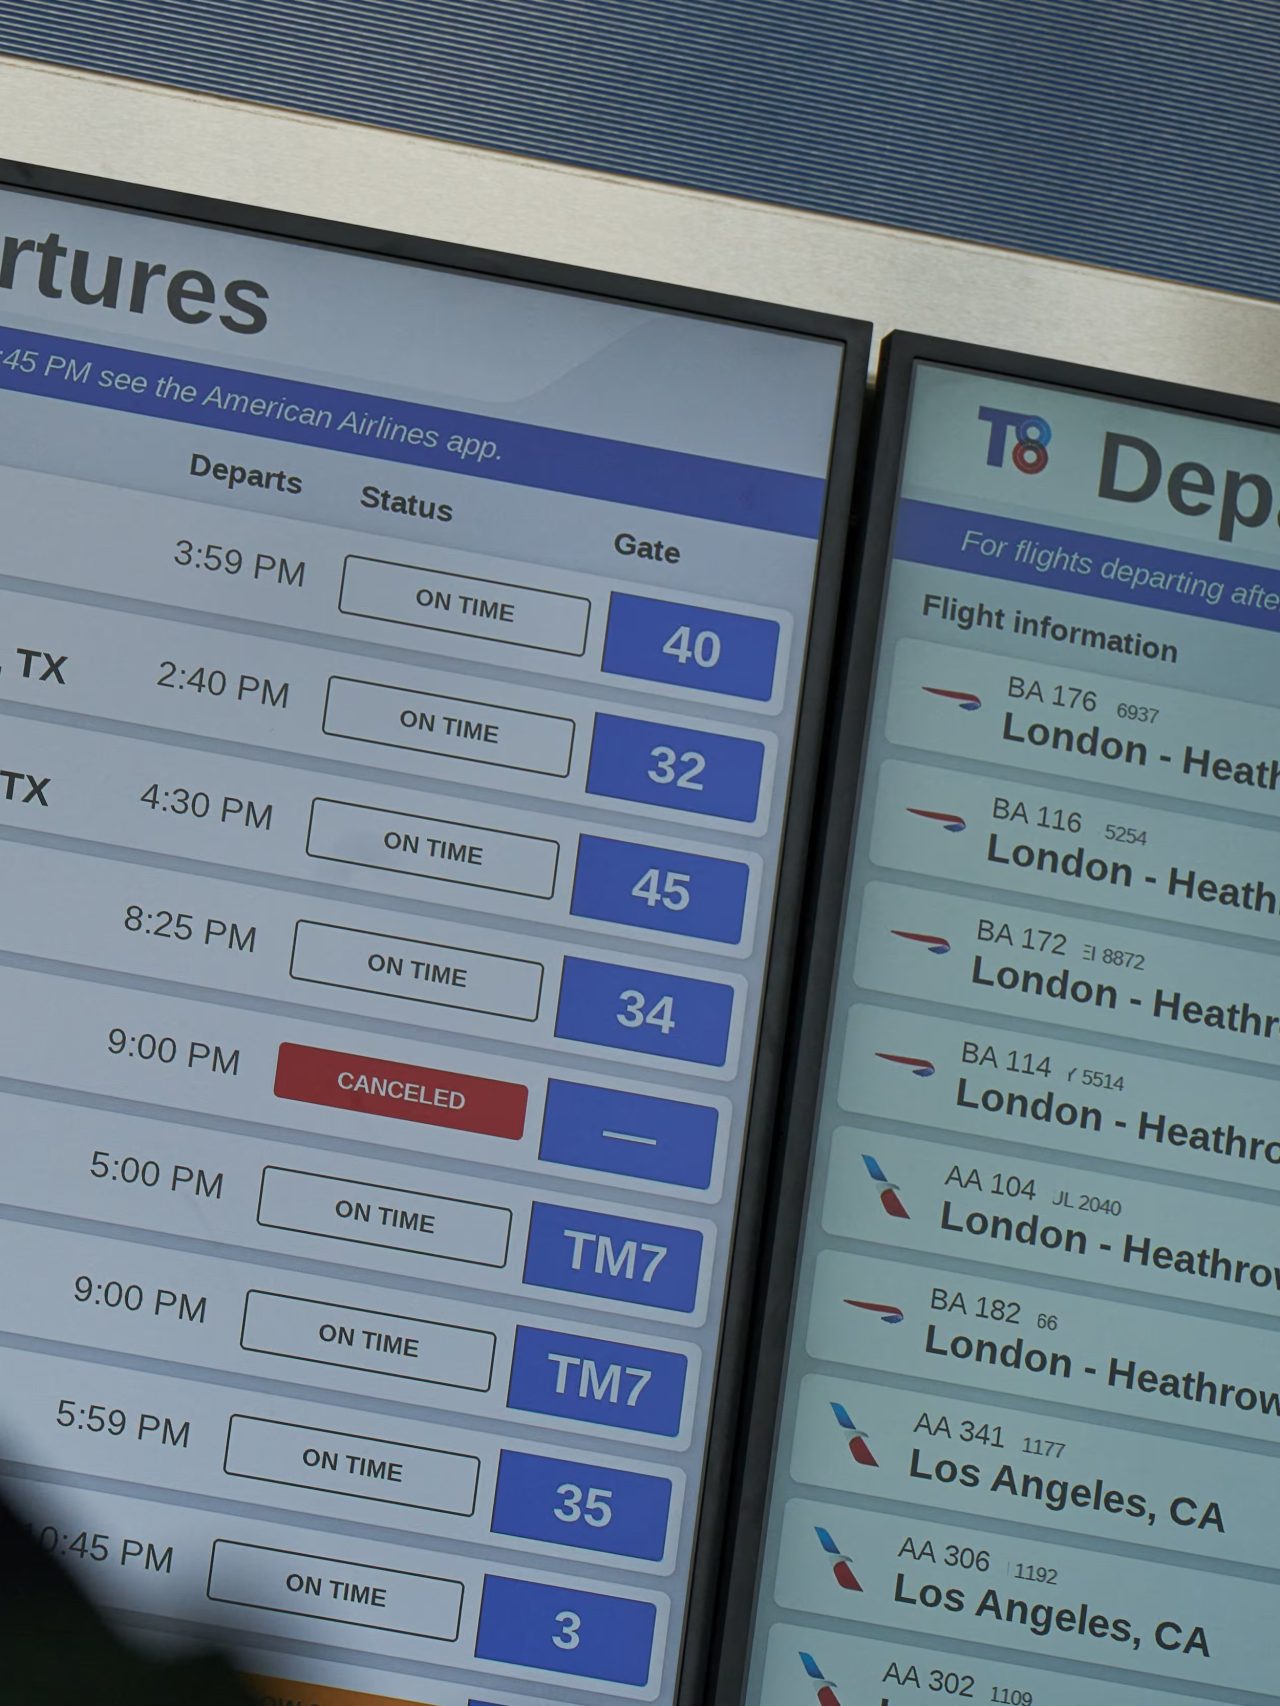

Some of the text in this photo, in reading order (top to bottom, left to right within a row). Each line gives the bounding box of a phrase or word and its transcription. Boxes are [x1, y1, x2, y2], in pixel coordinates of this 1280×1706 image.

[43, 354, 93, 383] PM
[98, 370, 148, 394] see
[155, 376, 198, 403] the
[201, 385, 333, 429] American
[336, 410, 439, 448] Airlines
[446, 434, 501, 463] app.
[977, 405, 1052, 475] T8
[189, 453, 681, 565] Departs Status Gate
[173, 539, 306, 588] 3:59 PM
[960, 529, 1225, 605] For flights departing
[662, 625, 722, 668] 40
[922, 594, 1178, 664] Flight information
[16, 647, 69, 685] TX
[156, 660, 290, 709] 2:40 PM
[1007, 675, 1160, 724] BA 176 6937
[1002, 711, 1147, 766] London
[0, 769, 51, 807] TX
[647, 745, 706, 791] 32
[140, 783, 273, 831] 4:30 PM
[992, 797, 1147, 846] BA 116 5254
[383, 831, 484, 866] ON TIME
[987, 832, 1133, 888] London
[631, 868, 691, 911] 45
[124, 904, 257, 953] 8:25 PM
[977, 918, 1145, 971] BA 172 8872
[971, 954, 1118, 1010] London
[616, 989, 676, 1035] 34
[107, 1027, 240, 1076] 9:00 PM
[961, 1041, 1124, 1092] BA 114 5514
[337, 1071, 466, 1110] CANCELED
[956, 1077, 1103, 1132] London
[90, 1150, 224, 1200] 5:00 PM
[944, 1165, 1122, 1217] AA 104 JL 2040
[335, 1199, 436, 1235] ON TIME
[940, 1200, 1087, 1255] London
[563, 1229, 668, 1283] TM7
[74, 1275, 207, 1324] 9:00 PM
[930, 1287, 1058, 1331] BA 182 66
[925, 1324, 1072, 1379] London
[547, 1353, 652, 1407] TM7
[56, 1399, 191, 1449] 5:59 PM
[912, 1412, 1066, 1459] AA 341 1177
[302, 1448, 404, 1483] ON TIME
[553, 1483, 613, 1528] 35
[909, 1448, 1226, 1534] Los Angeles, CA
[120, 1539, 174, 1574] PM
[897, 1536, 1058, 1586] AA 306 1192
[551, 1610, 582, 1650] 3
[894, 1572, 1211, 1658] Los Angeles, CA
[881, 1661, 975, 1698] AA 302
